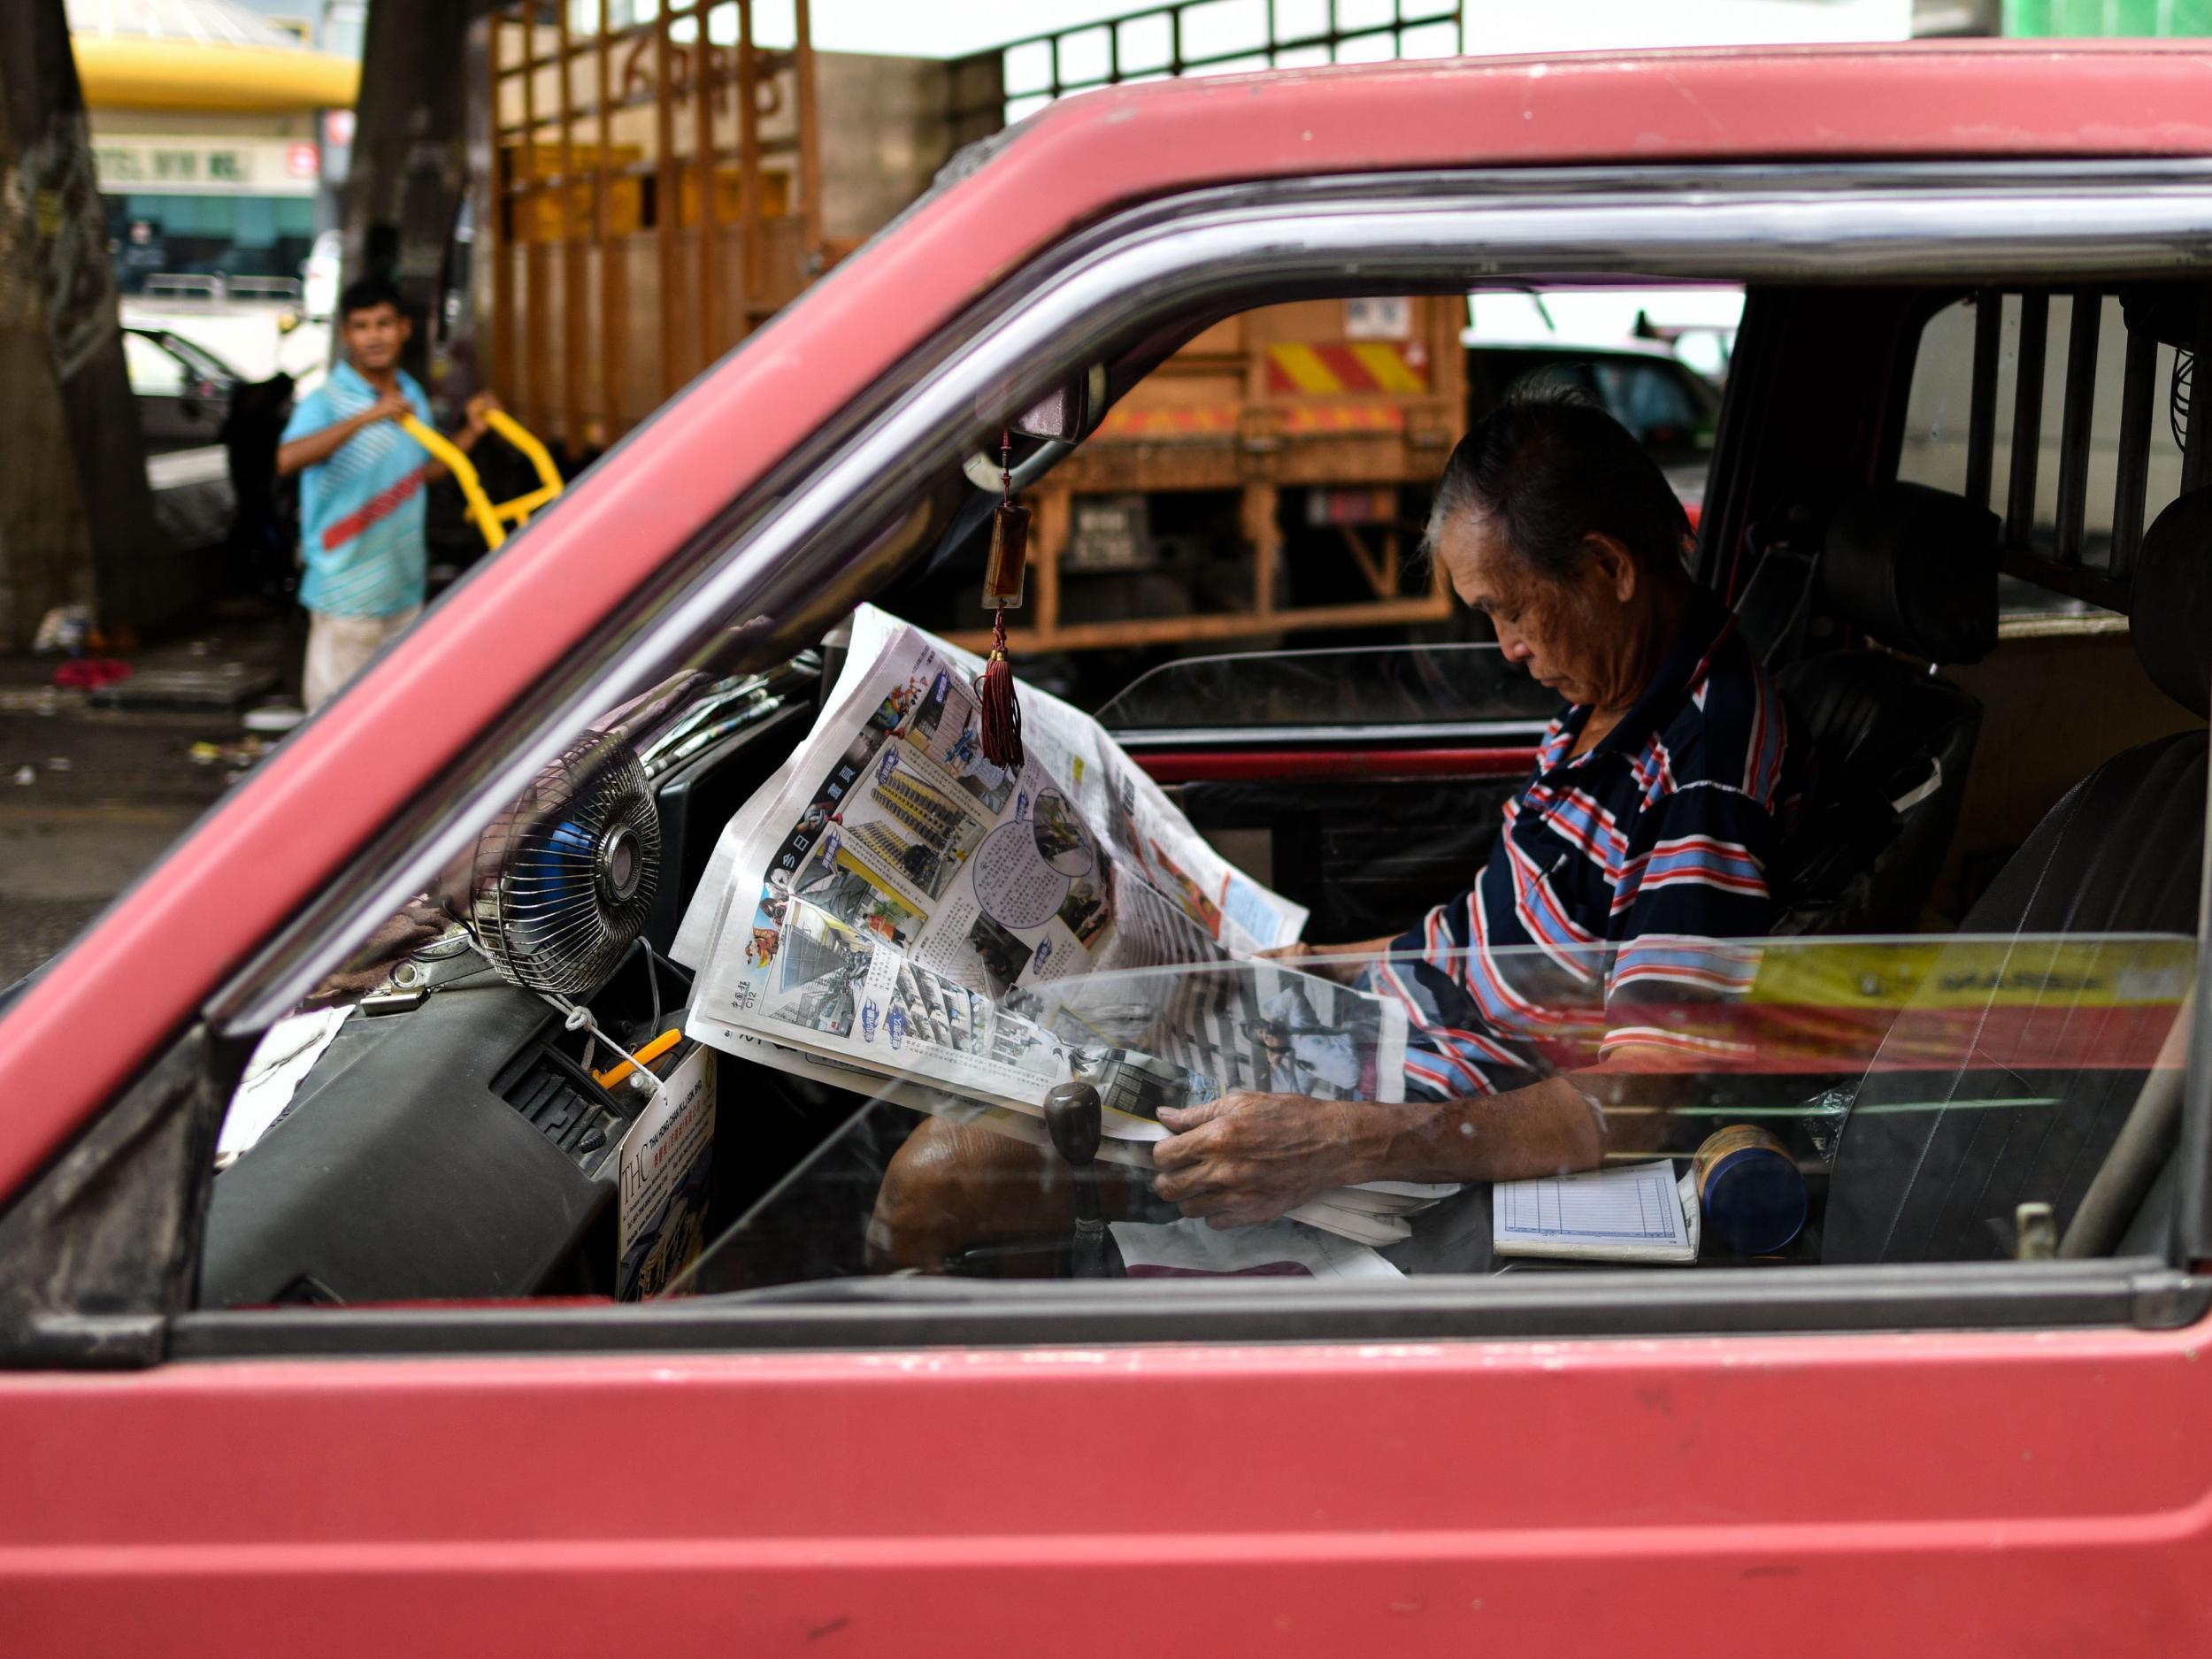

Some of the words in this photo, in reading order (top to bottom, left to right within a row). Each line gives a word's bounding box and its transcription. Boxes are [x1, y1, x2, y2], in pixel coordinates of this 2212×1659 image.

[782, 834, 809, 869] 今日
[745, 991, 757, 1009] C12
[649, 1133, 659, 1150] THAI
[658, 1119, 670, 1138] HONG
[669, 1110, 680, 1127] CHAN
[621, 1143, 650, 1205] THC
